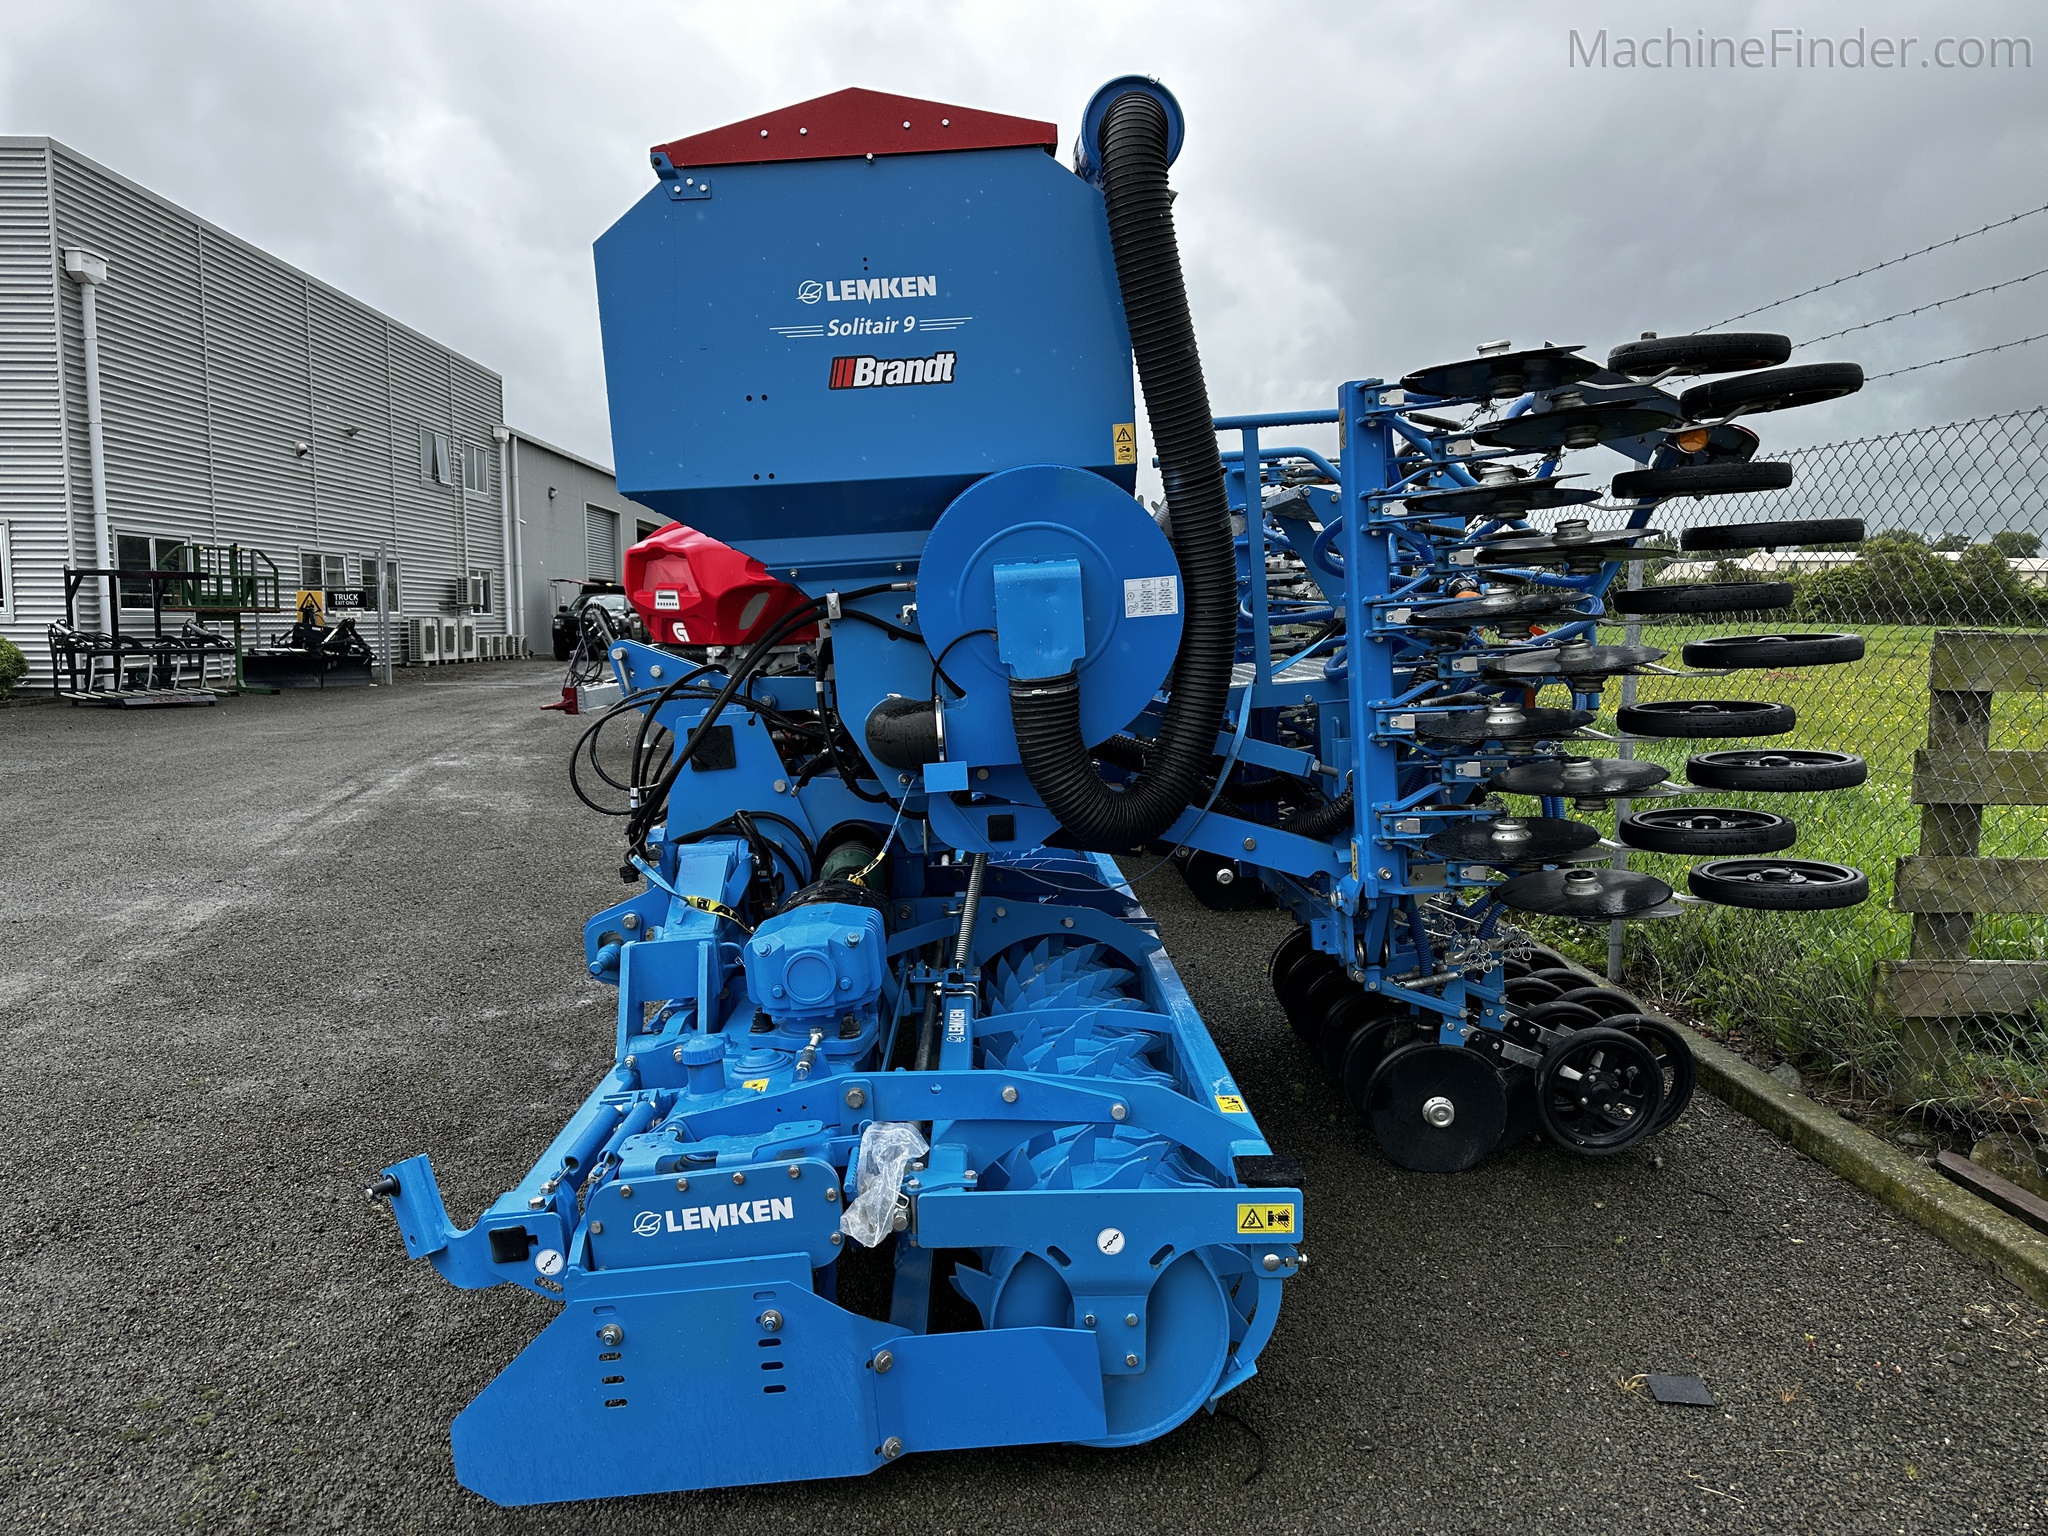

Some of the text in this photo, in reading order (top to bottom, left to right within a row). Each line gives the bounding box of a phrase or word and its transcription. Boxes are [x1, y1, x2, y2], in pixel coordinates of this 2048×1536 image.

[826, 275, 937, 305] LEMKEN
[827, 315, 916, 337] Solitair 9
[853, 353, 955, 387] Brandt
[334, 593, 359, 601] TRUCK
[948, 1009, 968, 1036] LEMKEN
[665, 1196, 794, 1233] LEMKEN
